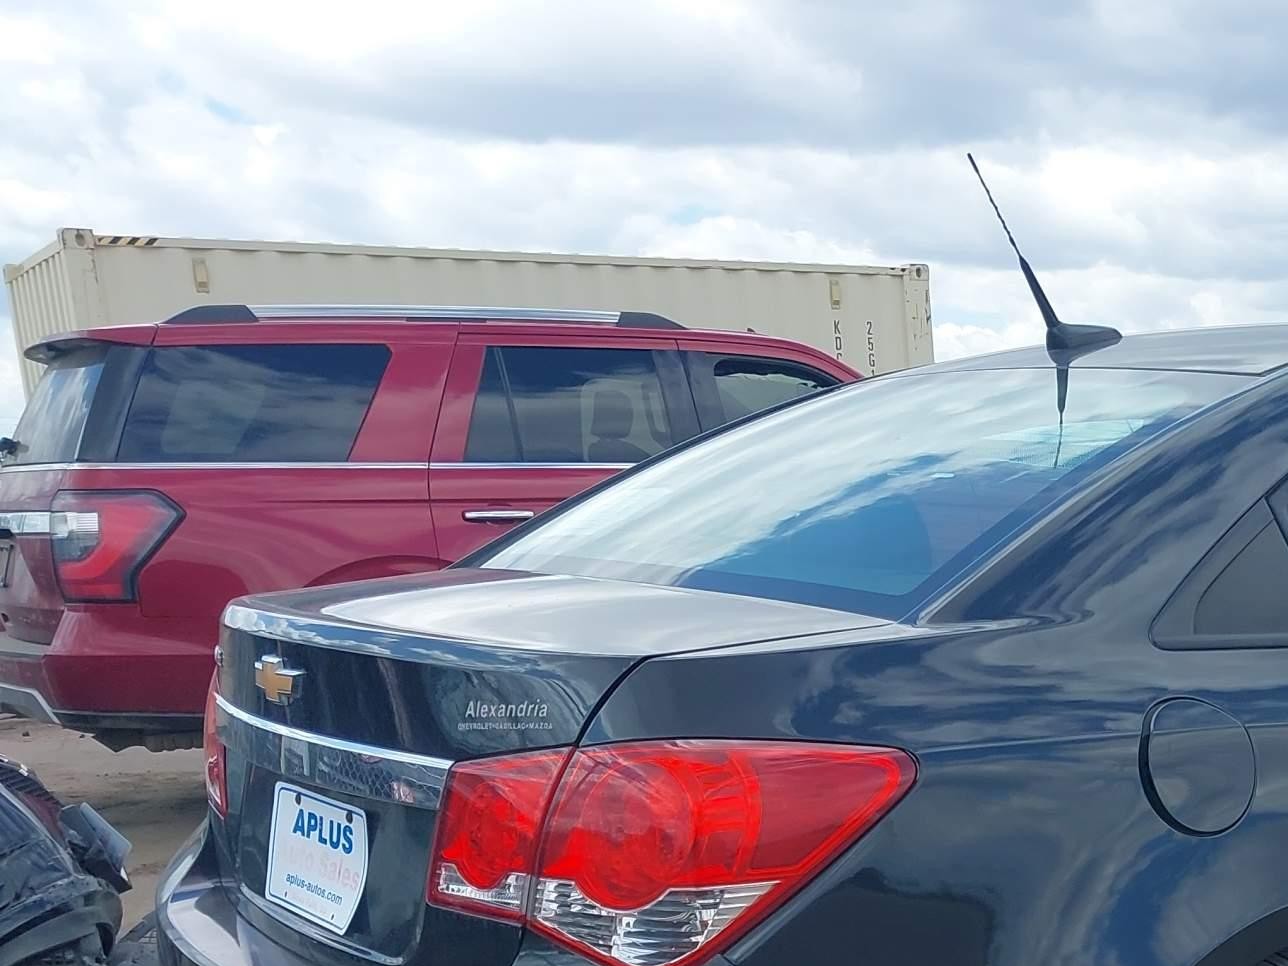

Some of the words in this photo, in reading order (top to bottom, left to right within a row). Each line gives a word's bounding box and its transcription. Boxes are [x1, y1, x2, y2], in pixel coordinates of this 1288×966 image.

[465, 698, 548, 719] Alexandria
[292, 808, 354, 855] APLUS
[285, 872, 343, 906] aplus-autos.com
